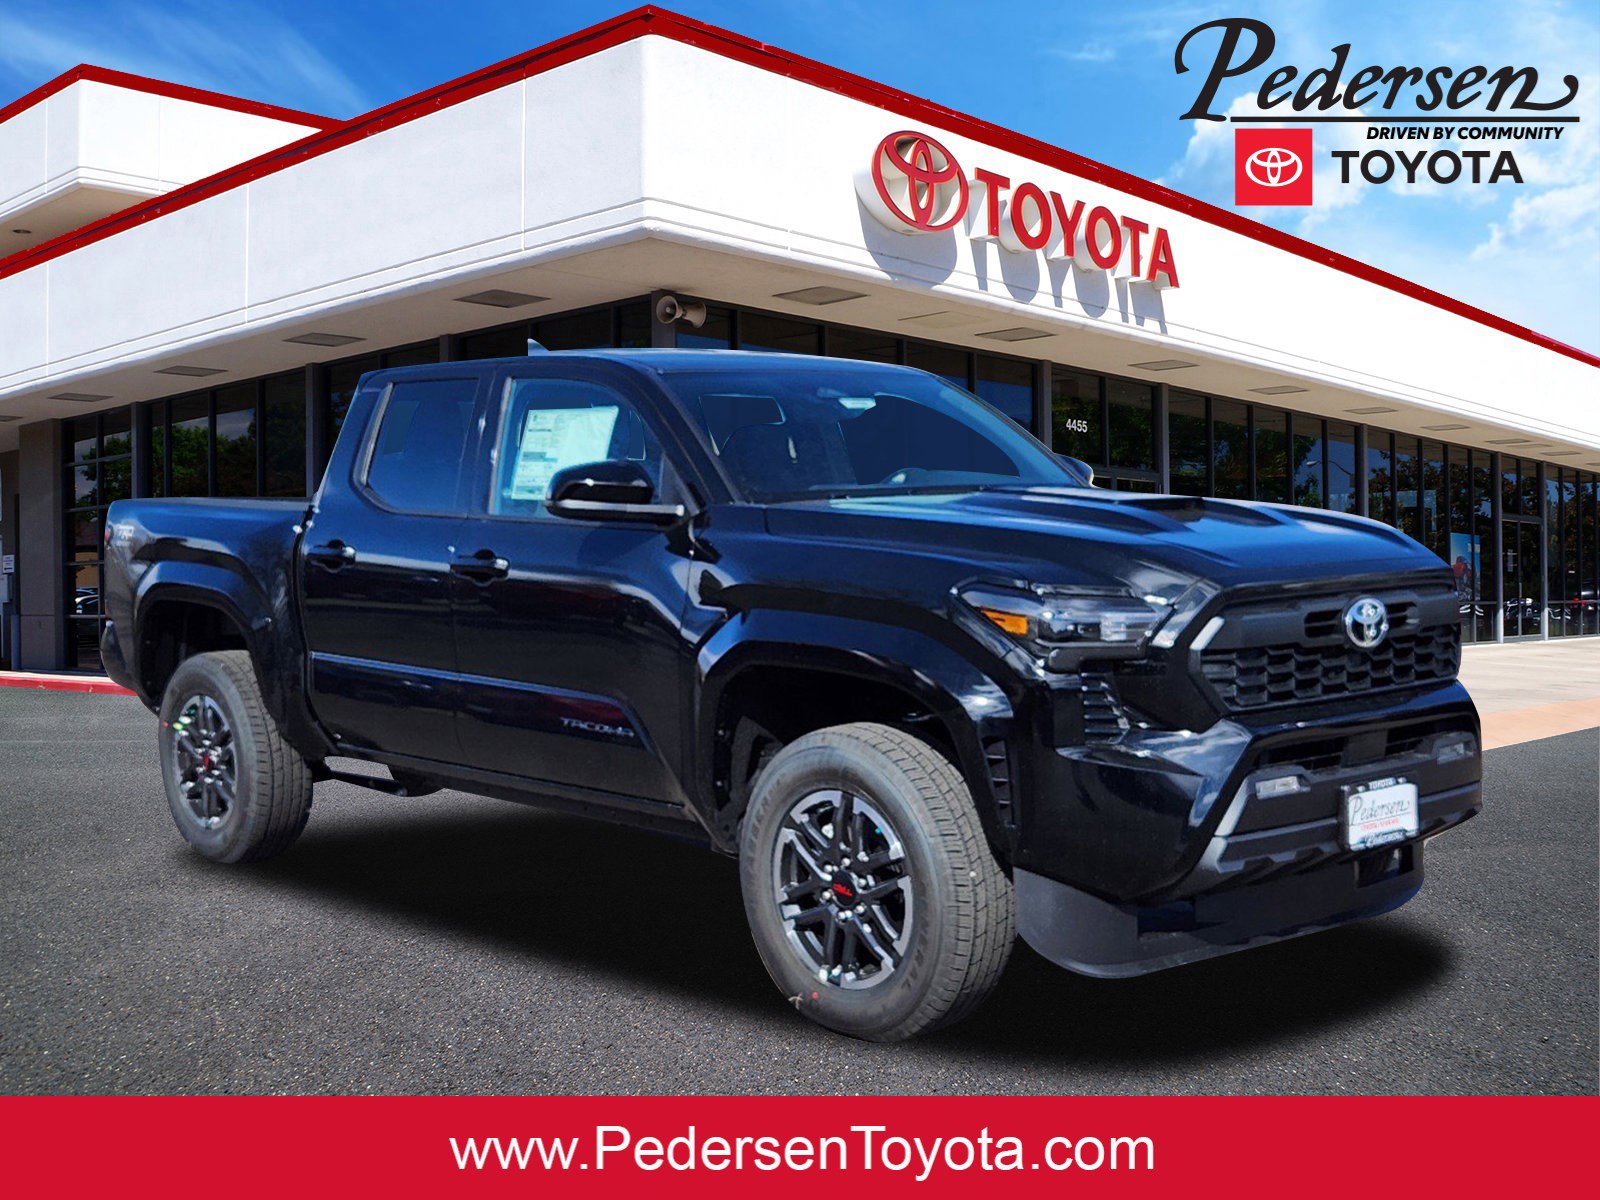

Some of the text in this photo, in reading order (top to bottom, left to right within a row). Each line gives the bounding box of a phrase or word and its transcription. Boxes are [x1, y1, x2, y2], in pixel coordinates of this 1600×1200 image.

[974, 166, 1180, 289] TOYOTA
[1065, 418, 1088, 433] 4455
[1350, 795, 1411, 826] Pedersen
